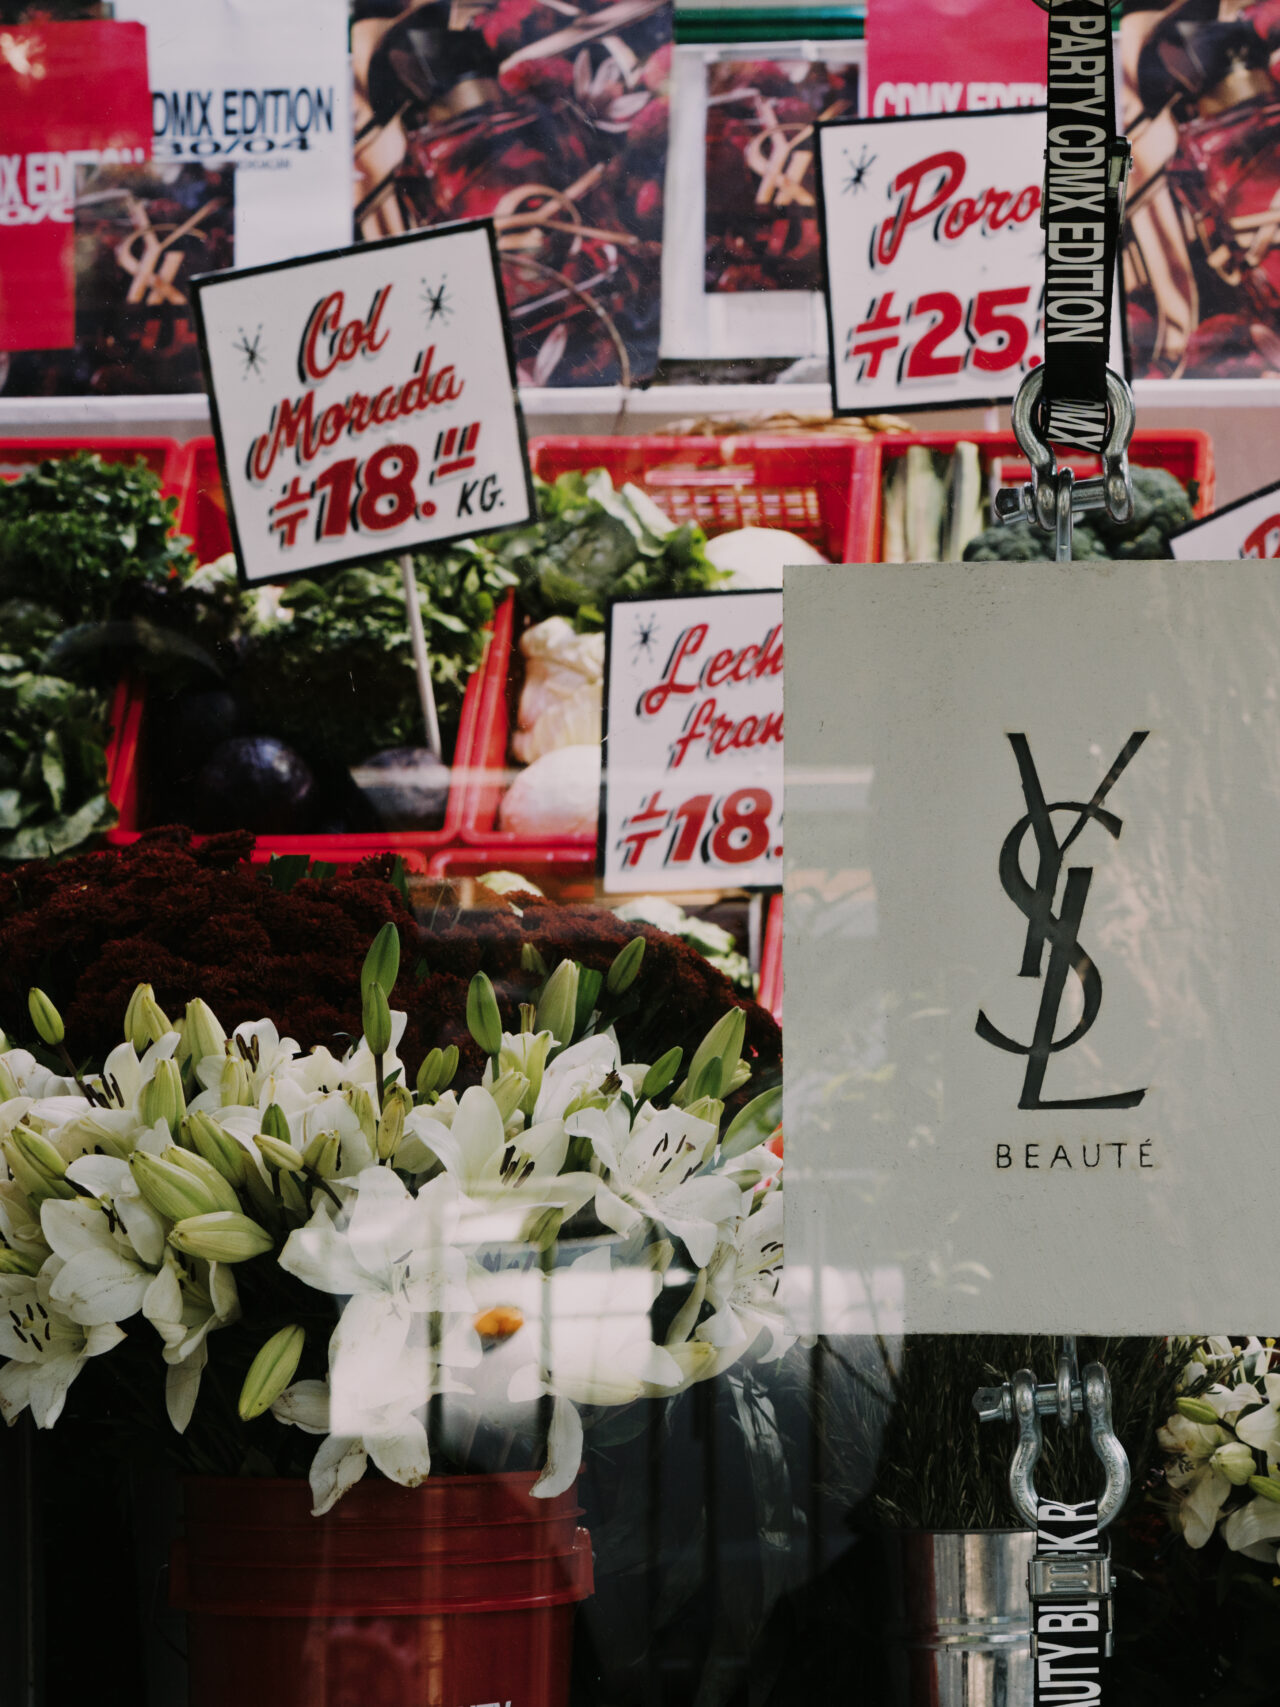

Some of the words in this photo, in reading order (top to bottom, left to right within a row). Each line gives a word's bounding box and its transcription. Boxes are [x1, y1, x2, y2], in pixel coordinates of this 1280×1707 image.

[151, 90, 213, 137] DMX
[223, 87, 334, 136] EDITION
[1049, 14, 1107, 117] PARTY
[870, 150, 1041, 271] Poro
[1047, 124, 1107, 215] CDMX
[1045, 221, 1106, 343] EDITION
[297, 283, 393, 386] Col
[246, 344, 464, 486] Morada
[995, 1138, 1155, 1170] BEAUTÉ
